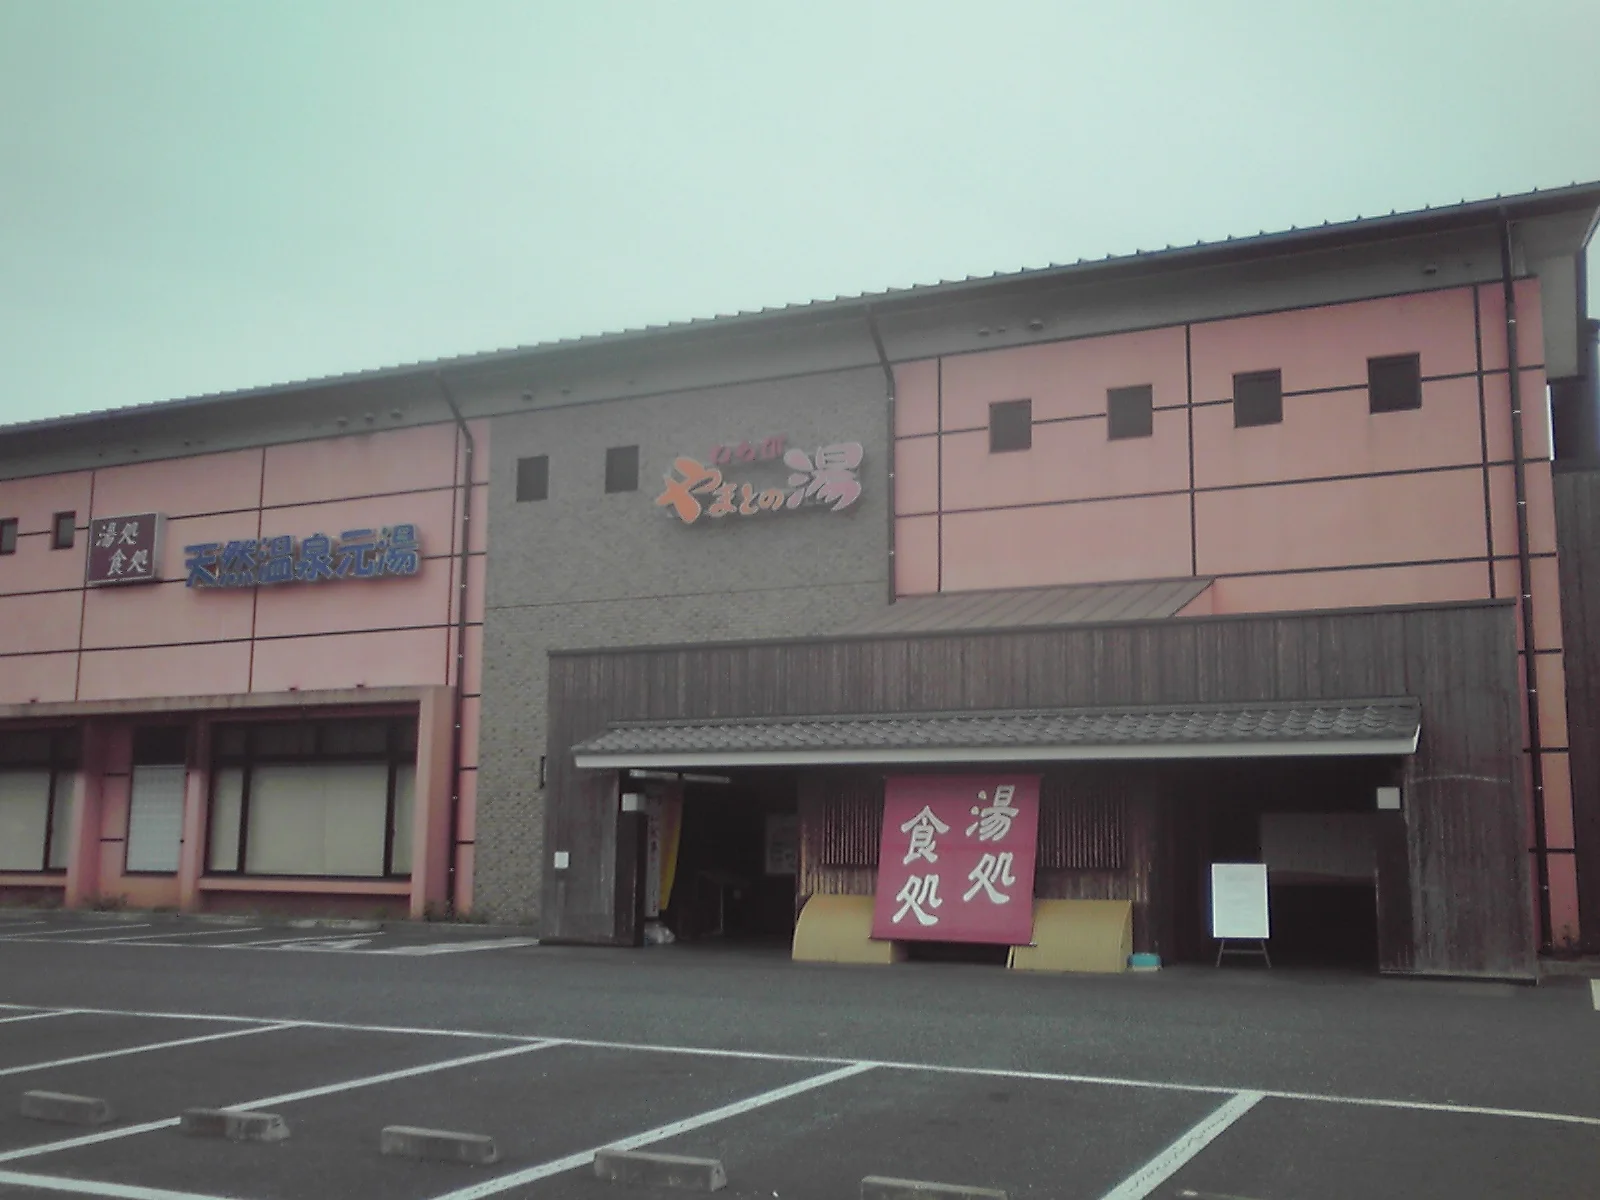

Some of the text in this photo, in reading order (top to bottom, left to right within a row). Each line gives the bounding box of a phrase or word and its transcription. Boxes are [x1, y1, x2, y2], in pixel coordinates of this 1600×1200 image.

[656, 442, 863, 523] やまとの湯
[95, 522, 140, 548] 湯処
[107, 548, 149, 576] 食処
[184, 524, 421, 588] 天然温泉元湯
[891, 805, 950, 926] 食処
[963, 784, 1020, 905] 湯処
